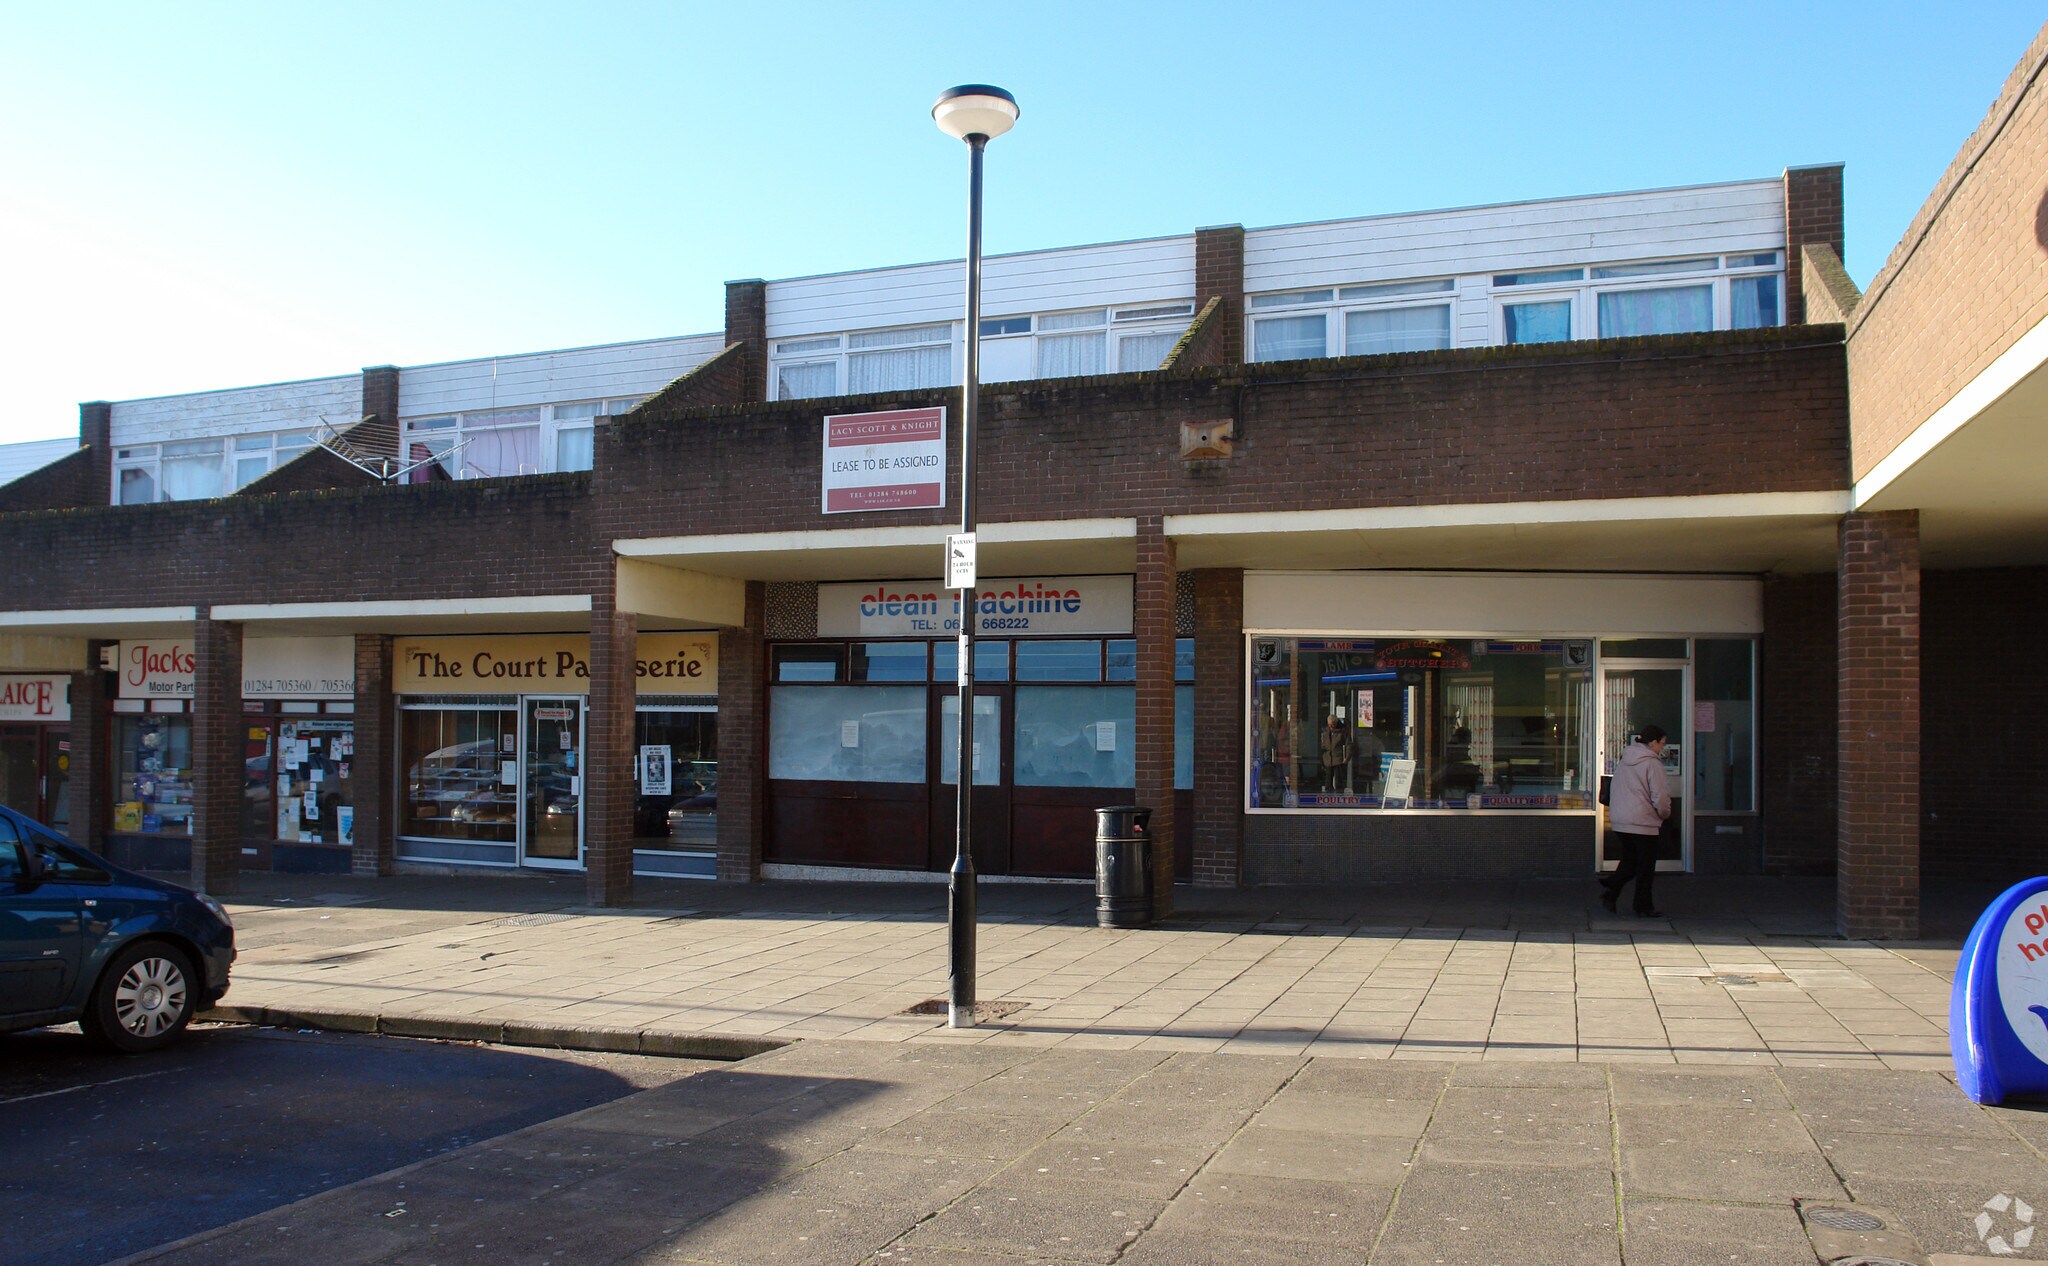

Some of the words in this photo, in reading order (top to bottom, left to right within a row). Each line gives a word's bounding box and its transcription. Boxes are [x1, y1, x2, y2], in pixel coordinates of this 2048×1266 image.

[831, 427, 854, 436] LACY
[857, 424, 887, 434] SCOTT
[901, 420, 939, 430] KNIGHT
[832, 460, 859, 473] LEASE
[863, 459, 876, 470] TO
[879, 458, 890, 469] BE
[893, 455, 939, 469] ASSIGNED
[861, 587, 937, 616] clean
[911, 619, 937, 630] TEL:
[982, 618, 1029, 629] 668222
[1324, 641, 1352, 649] LAMB
[1513, 643, 1540, 652] PORK
[413, 652, 462, 678] The
[472, 652, 547, 678] Court
[149, 682, 173, 692] Motor
[176, 681, 194, 692] Part
[244, 680, 273, 691] 01284
[276, 680, 312, 691] 705360
[1316, 796, 1360, 804] POULTRY
[1489, 796, 1531, 806] QUALITY
[1534, 796, 1553, 805] BEEF
